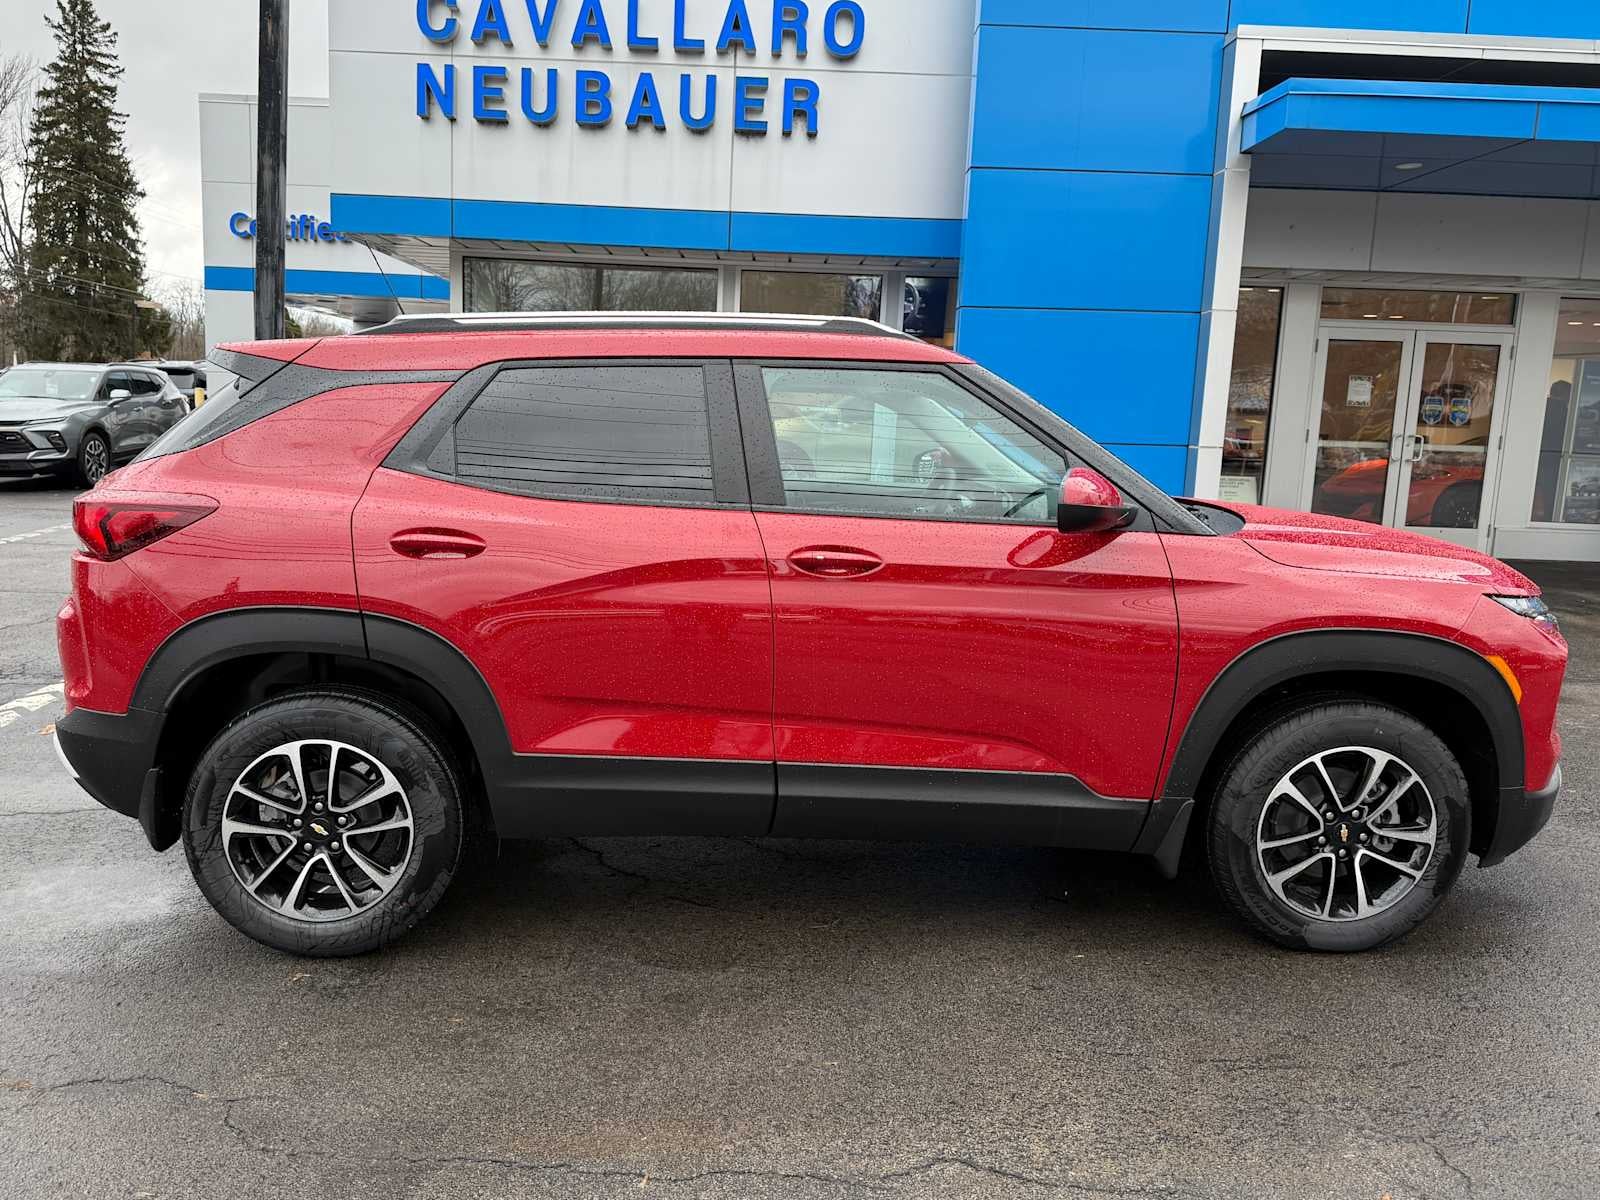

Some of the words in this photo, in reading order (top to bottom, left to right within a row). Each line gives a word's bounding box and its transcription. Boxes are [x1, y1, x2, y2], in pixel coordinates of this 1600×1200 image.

[416, 0, 866, 59] CAVALLARO
[416, 62, 820, 136] NEUBAUER
[229, 211, 347, 242] Cifie
